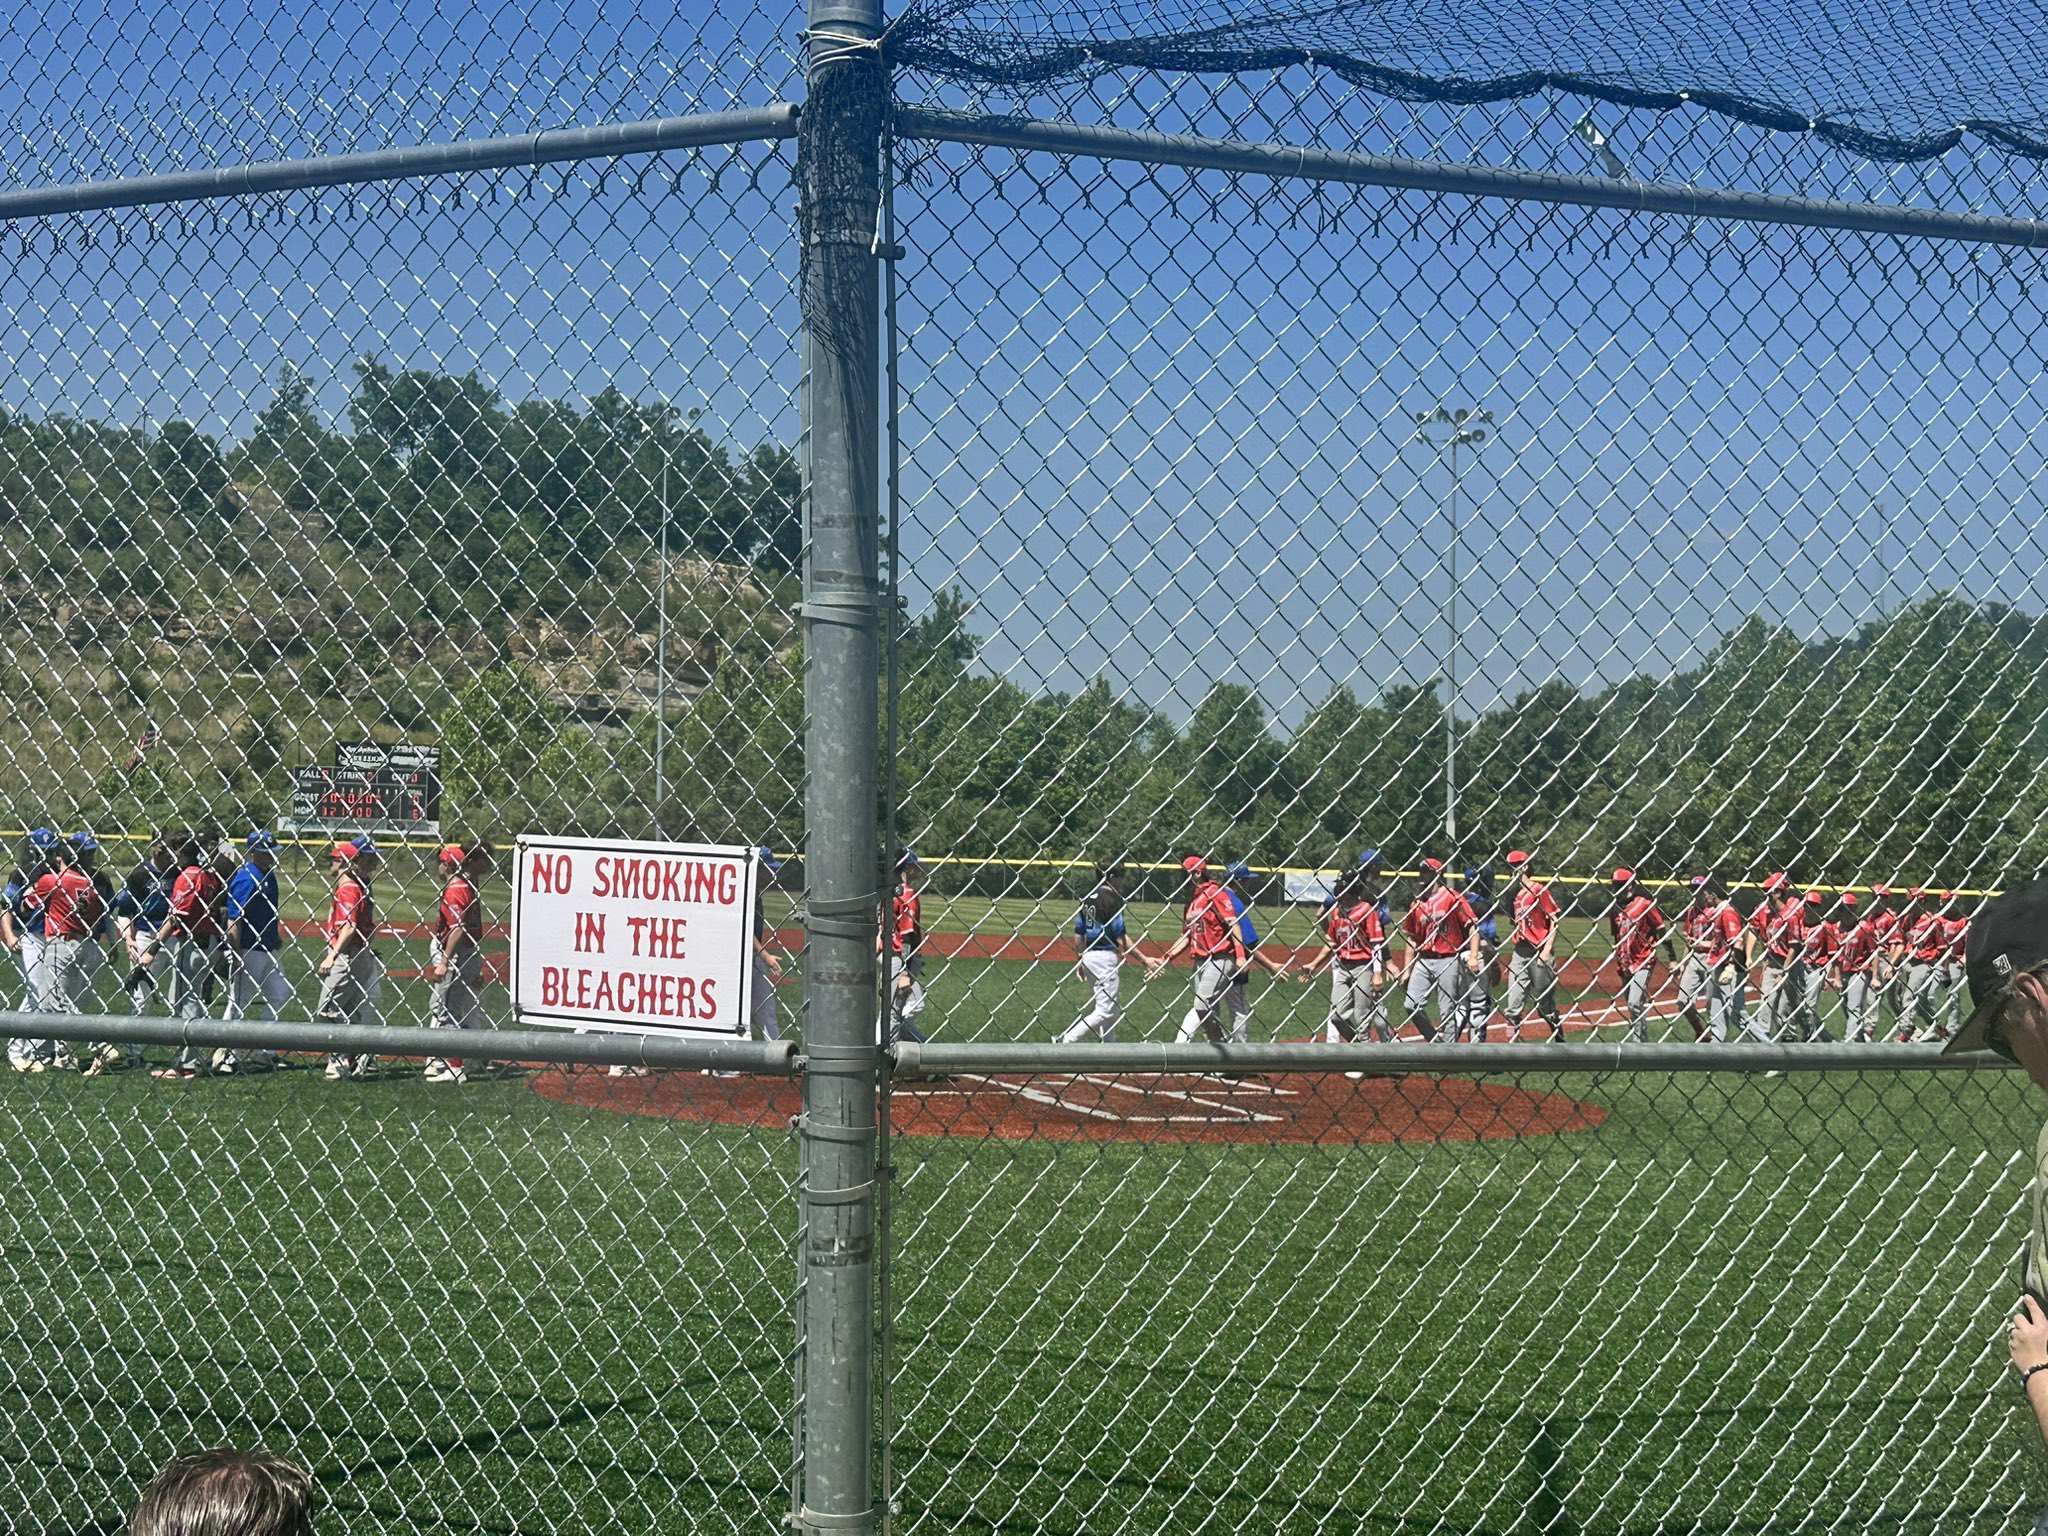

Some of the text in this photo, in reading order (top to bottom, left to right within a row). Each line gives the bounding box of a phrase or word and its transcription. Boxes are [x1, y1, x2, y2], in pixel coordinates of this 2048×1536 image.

[532, 853, 736, 905] NO SMOKING
[574, 912, 687, 959] IN THE
[542, 966, 717, 1020] BLEACHERS
